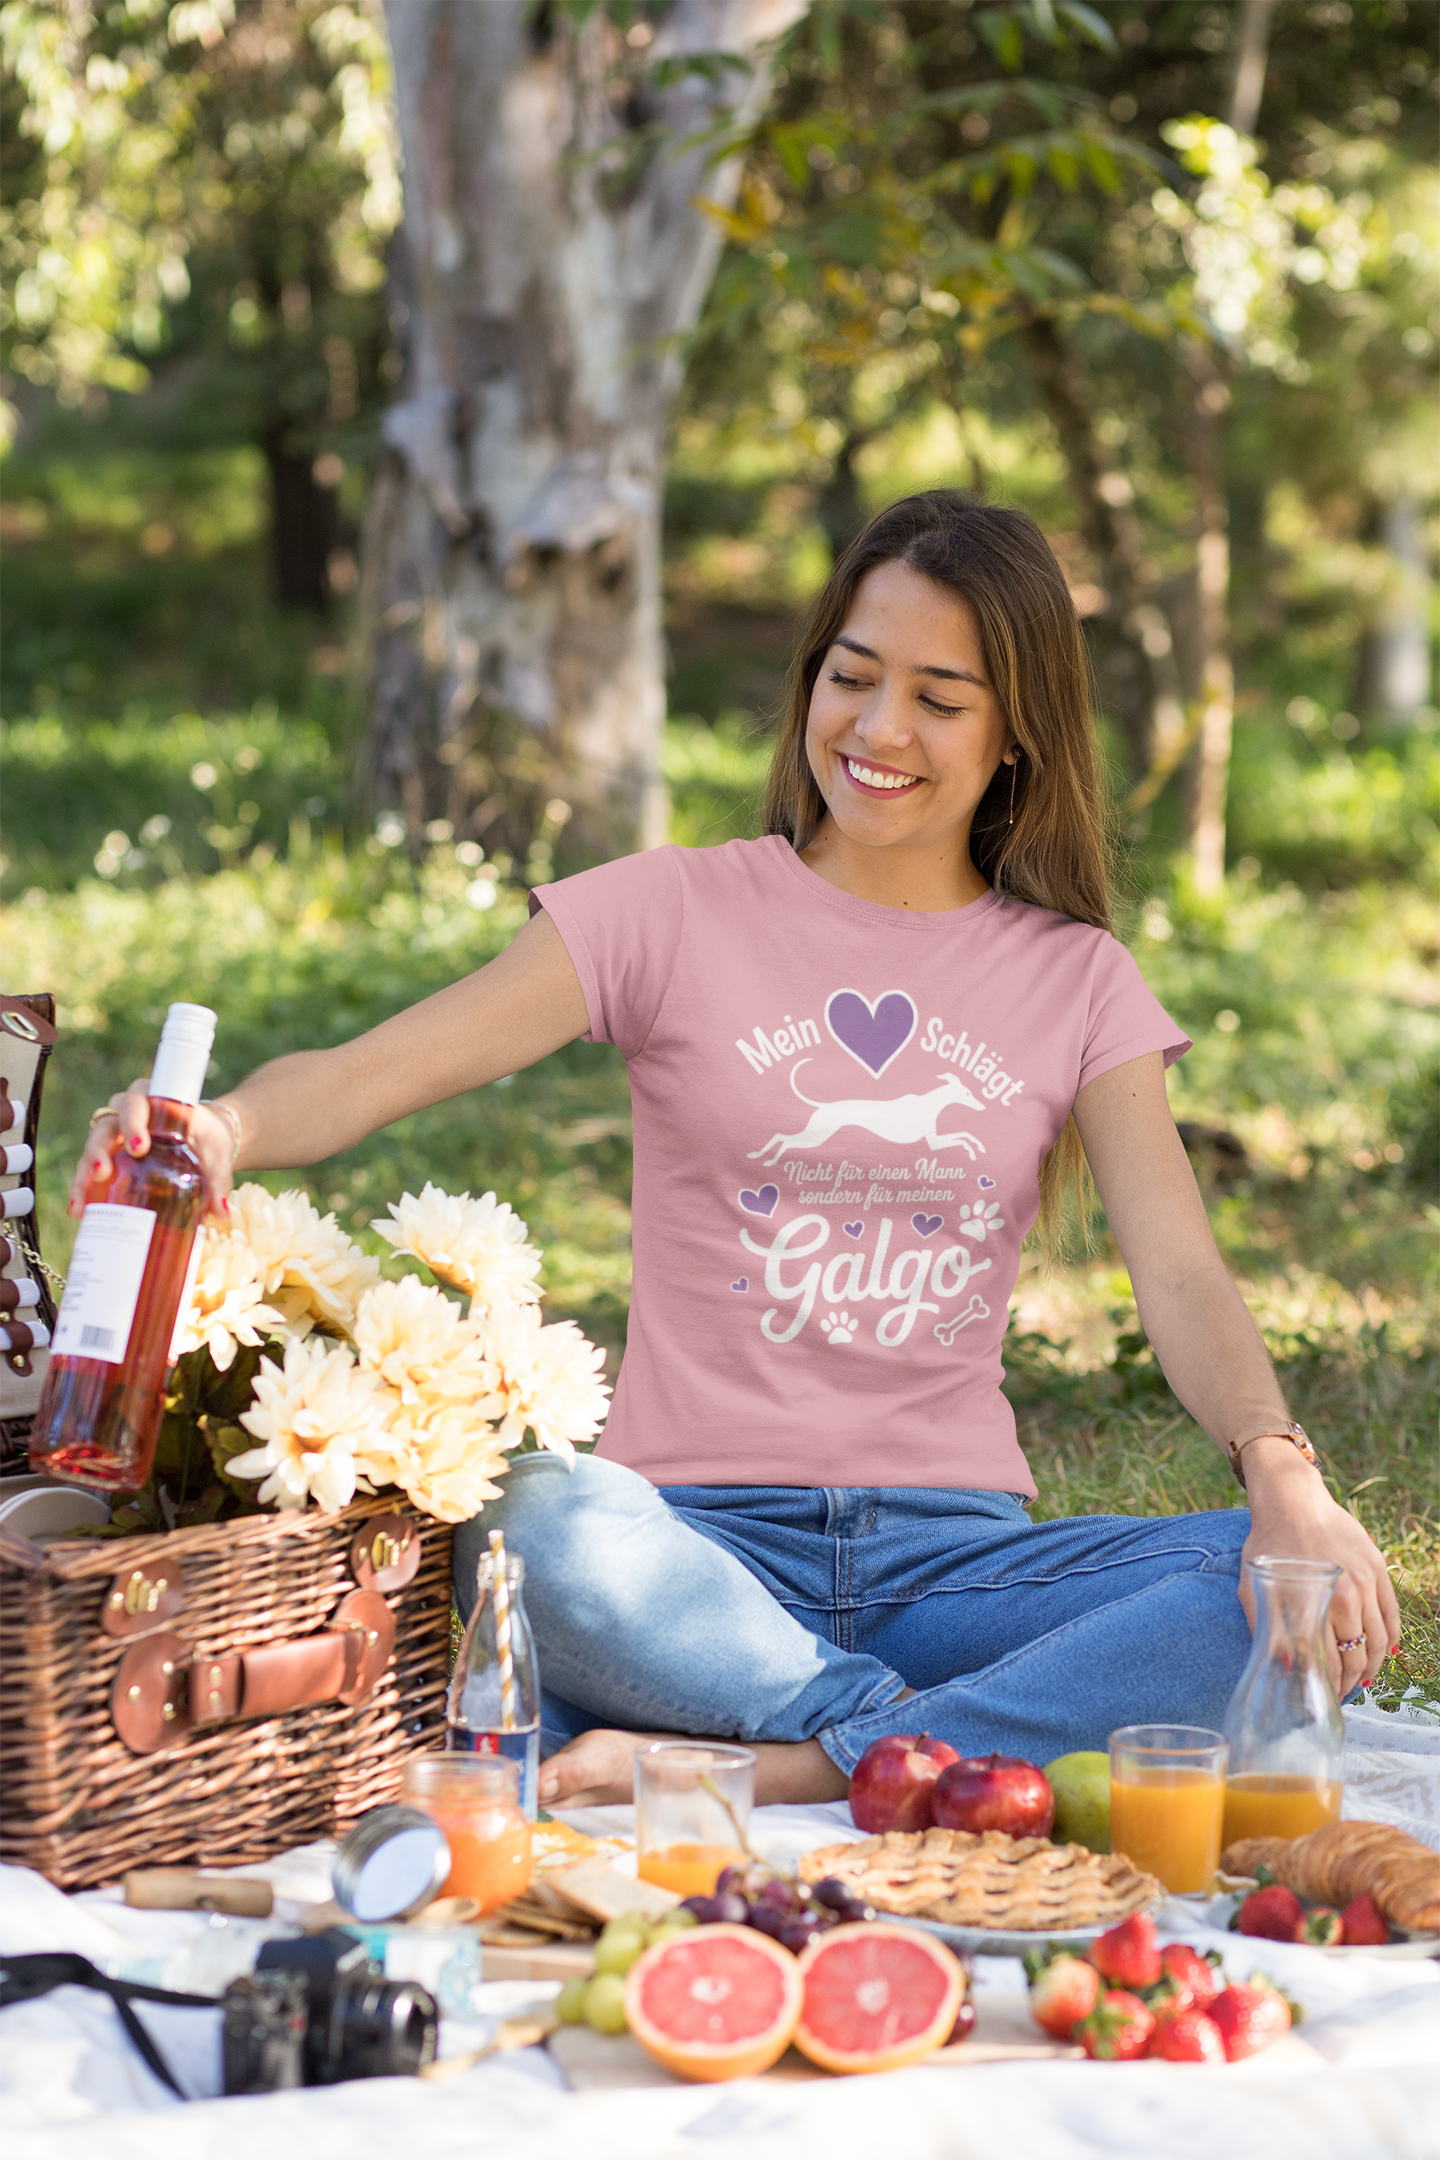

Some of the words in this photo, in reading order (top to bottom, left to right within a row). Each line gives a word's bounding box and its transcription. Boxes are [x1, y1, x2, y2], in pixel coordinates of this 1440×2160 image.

[735, 1015, 822, 1075] Mein
[920, 1017, 1025, 1106] Schlägt
[783, 1160, 834, 1185] Nicht
[835, 1160, 865, 1188] für
[868, 1164, 911, 1181] einen
[915, 1157, 966, 1184] Mann
[799, 1187, 863, 1204] sondern
[863, 1183, 893, 1211] für
[896, 1186, 955, 1203] meinen
[739, 1213, 992, 1347] Galgo
